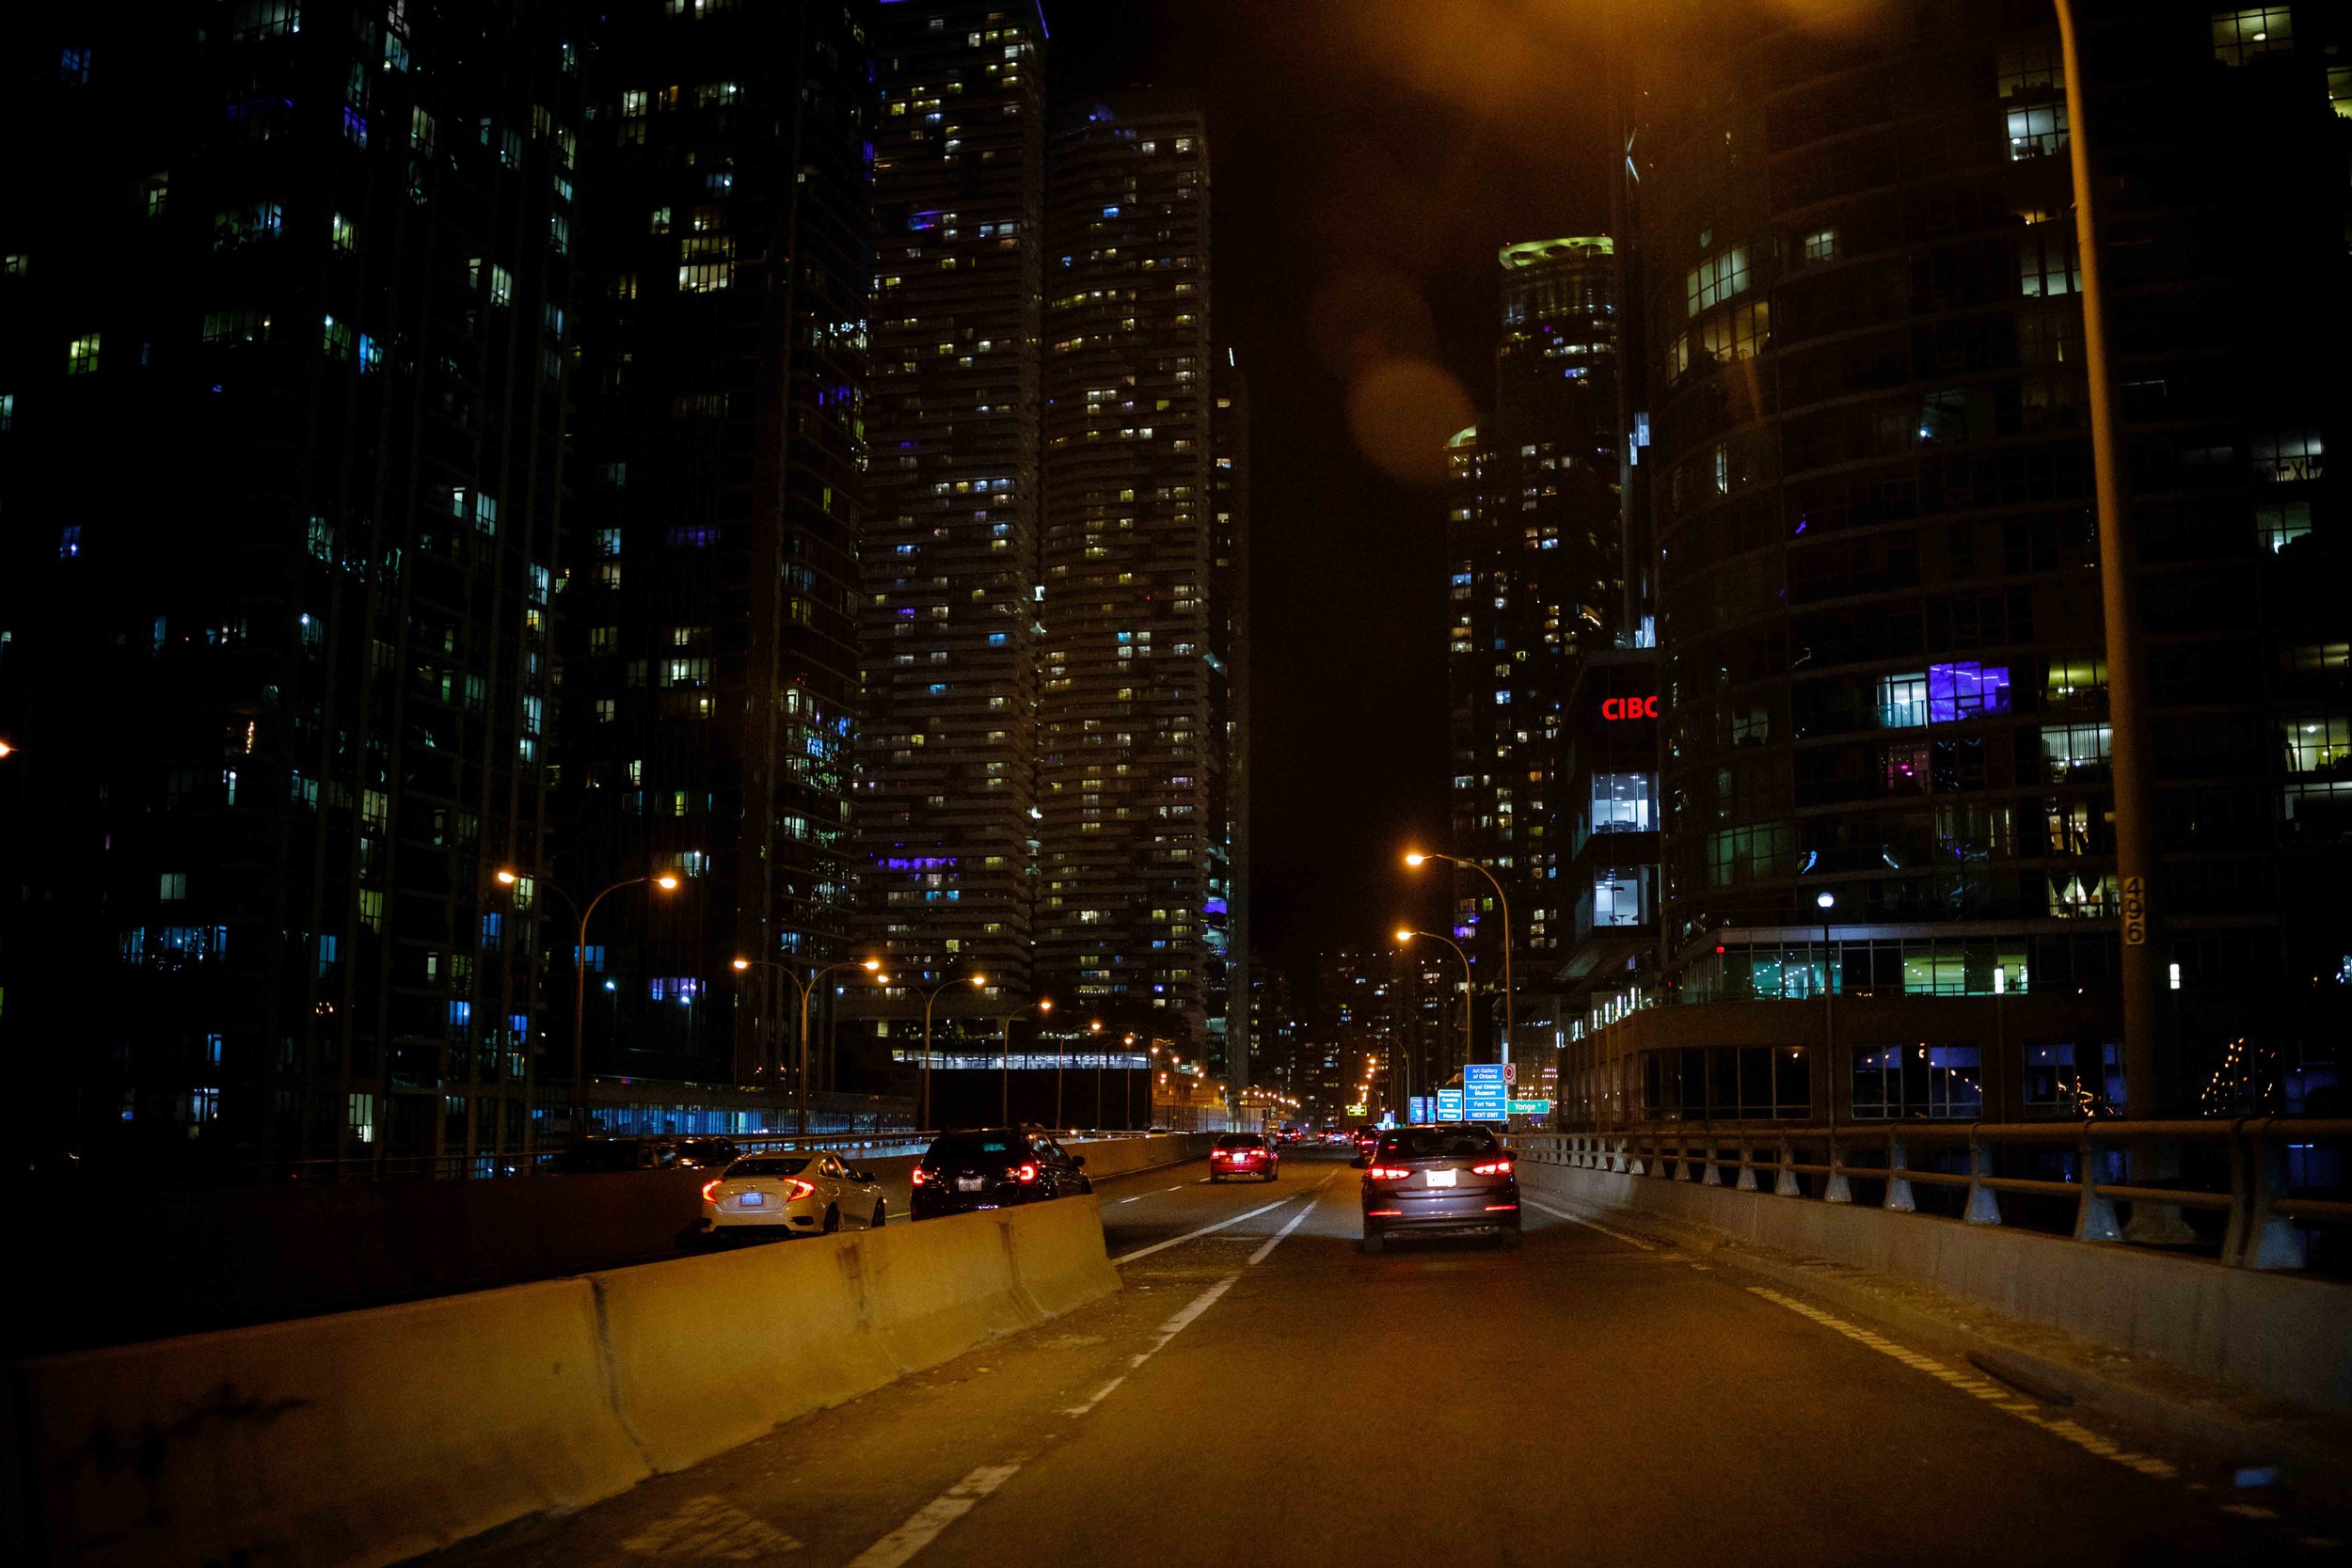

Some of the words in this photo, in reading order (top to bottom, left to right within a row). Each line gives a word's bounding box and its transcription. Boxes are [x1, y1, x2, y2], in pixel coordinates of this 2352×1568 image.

[1602, 695, 1659, 721] CIBC
[2126, 877, 2142, 942] 496
[1514, 1102, 1536, 1113] Yonge
